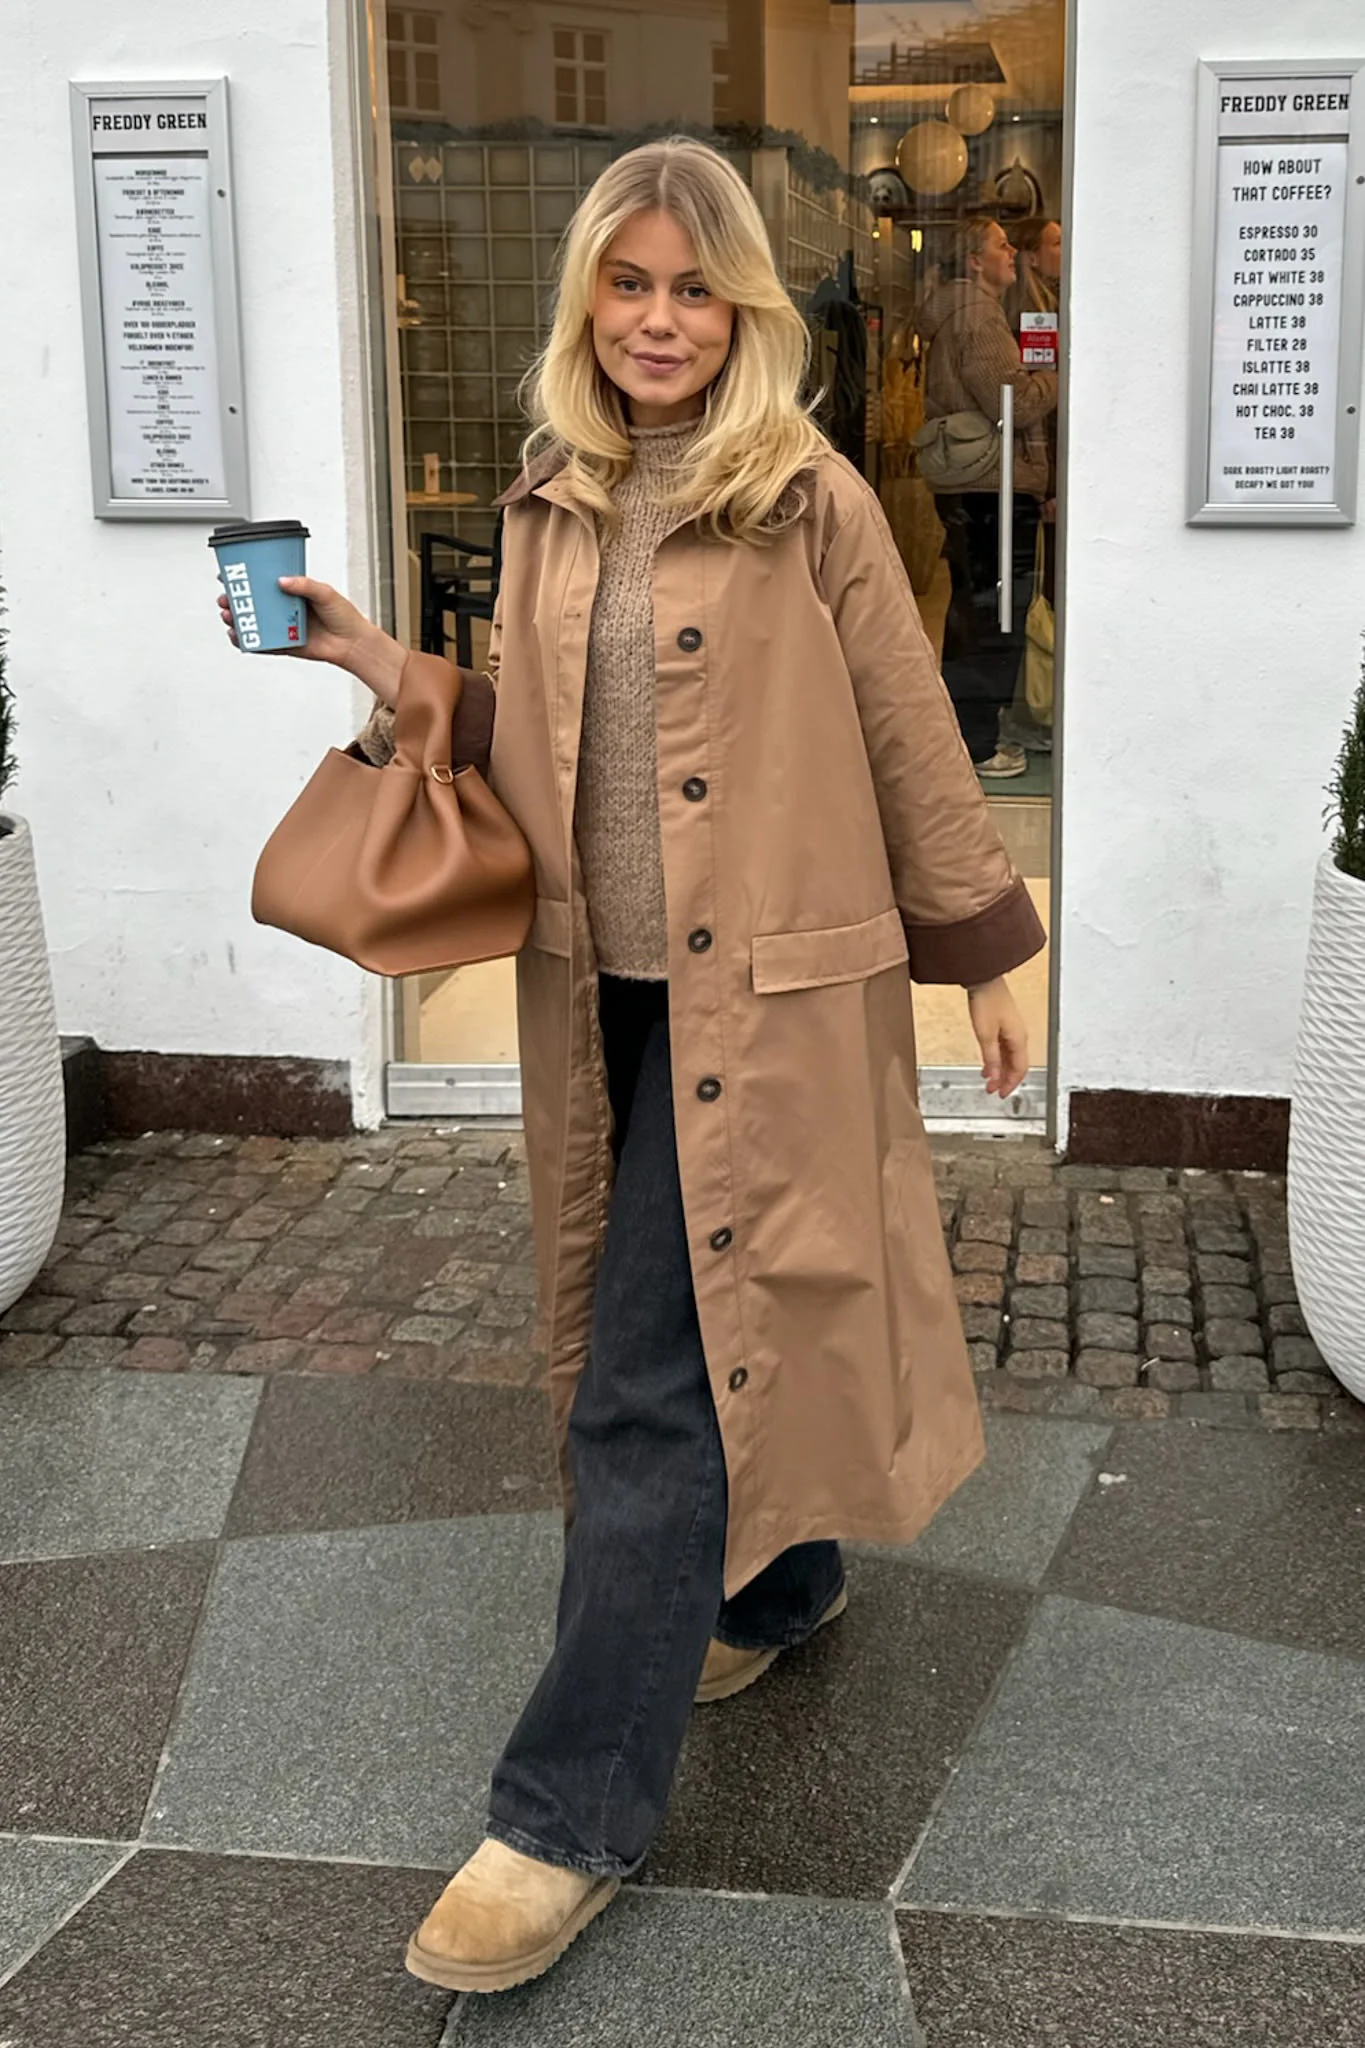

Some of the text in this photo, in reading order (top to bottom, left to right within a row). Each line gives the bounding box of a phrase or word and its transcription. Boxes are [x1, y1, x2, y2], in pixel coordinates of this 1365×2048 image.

[1221, 94, 1349, 113] FREDDY GREEN
[92, 113, 207, 131] FREDDY GREEN
[1244, 159, 1321, 175] HOW ABOUT
[1233, 185, 1332, 202] THAT COFFEE?
[1240, 225, 1318, 239] ESPRESSO 30
[1244, 248, 1315, 262] CORTADO 35
[1234, 270, 1324, 285] FLAT WHITE 38
[1234, 293, 1323, 307] CAPPUCCINO 38
[1249, 316, 1306, 329] LATTE 38
[1247, 338, 1307, 351] FILTER 28
[1243, 361, 1310, 373] ISLATTE 38
[1233, 382, 1319, 395] CHAI LATTE 38
[1236, 405, 1314, 417] HOT CHOC. 38
[1255, 427, 1295, 439] TEA 38
[1223, 466, 1330, 475] DARK ROAST? LIGHT ROAST?
[1235, 480, 1264, 489] DECAF?
[1267, 480, 1277, 488] WE
[1280, 480, 1295, 489] GOT
[224, 561, 262, 650] GREEN
